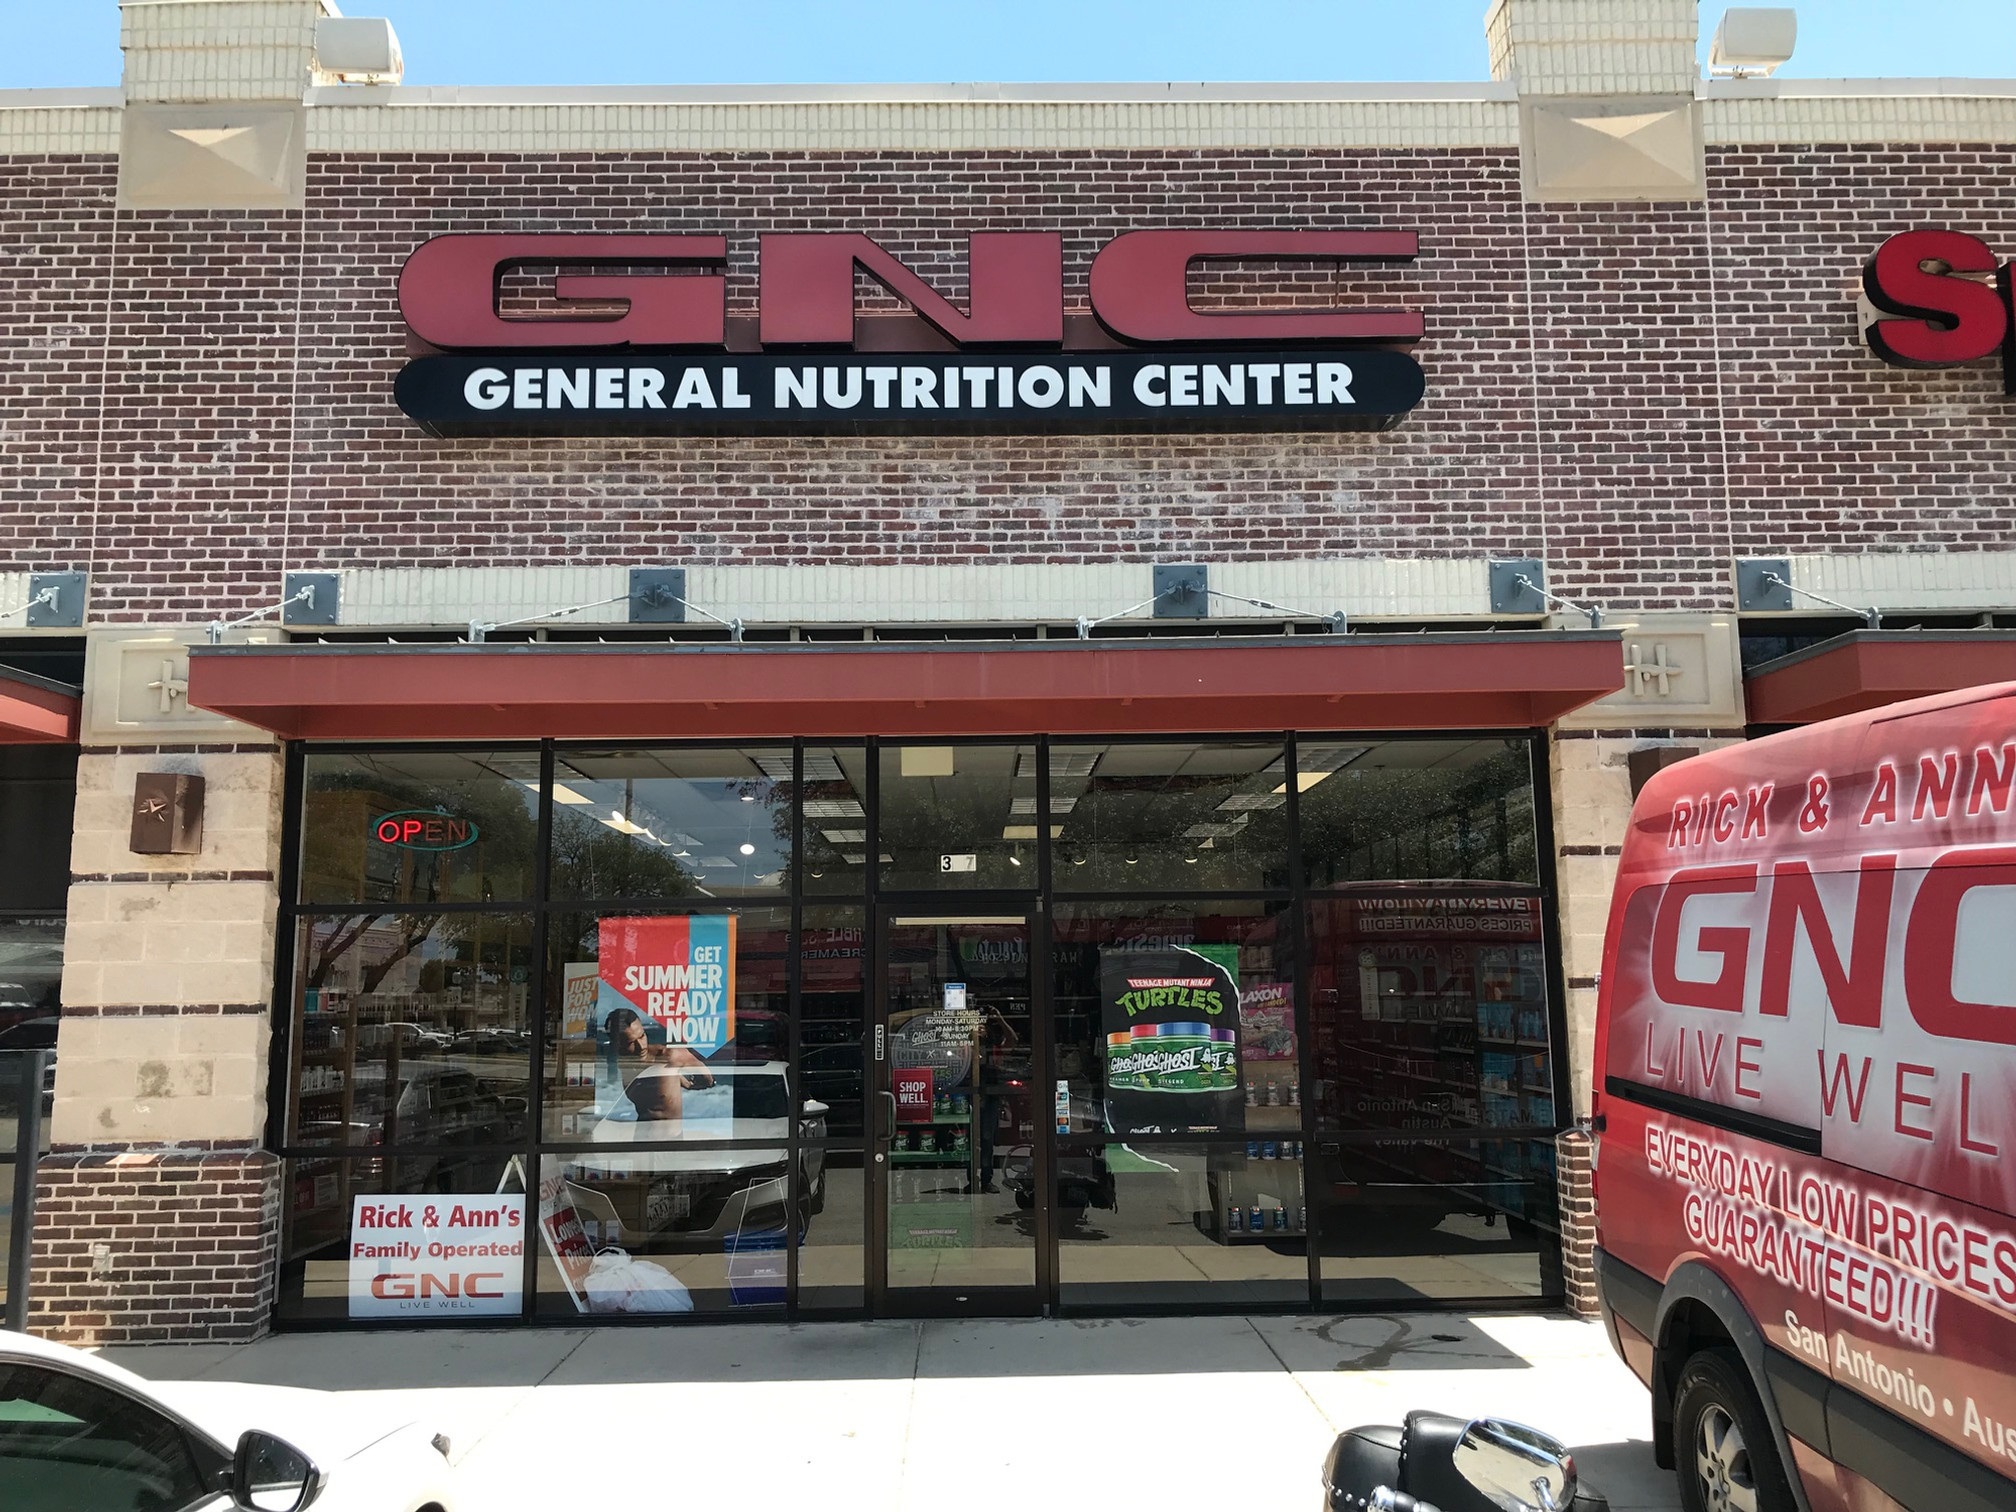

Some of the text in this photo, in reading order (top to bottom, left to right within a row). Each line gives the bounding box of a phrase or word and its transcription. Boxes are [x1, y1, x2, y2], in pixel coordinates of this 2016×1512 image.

[398, 230, 1425, 349] GNC
[1863, 228, 2016, 395] S
[463, 361, 1356, 410] GENERAL NUTRITION CENTER
[1668, 782, 1774, 849] RICK
[1798, 775, 1830, 833] &
[377, 819, 467, 843] OPEN
[694, 946, 722, 963] GET
[1650, 847, 2016, 1046] GNC
[625, 965, 722, 991] SUMMER
[1128, 978, 1213, 988] TEENAGE MUTANT NINJA
[568, 991, 592, 1008] FOR
[648, 991, 722, 1017] READY
[1115, 986, 1224, 1017] TURTLES
[666, 1017, 720, 1042] NOW
[1645, 1022, 1764, 1101] LIVE
[899, 1081, 926, 1092] SHOP
[359, 1204, 521, 1228] Rick & Ann's
[1646, 1126, 2016, 1304] EVERYDAY LOW PRICES
[353, 1240, 523, 1261] Family Operated
[1685, 1195, 1937, 1345] GUARANTEED!!!
[371, 1273, 504, 1299] GNC
[400, 1301, 430, 1309] LIVE
[1785, 1309, 1829, 1364] San
[1834, 1333, 1936, 1418] Antonio
